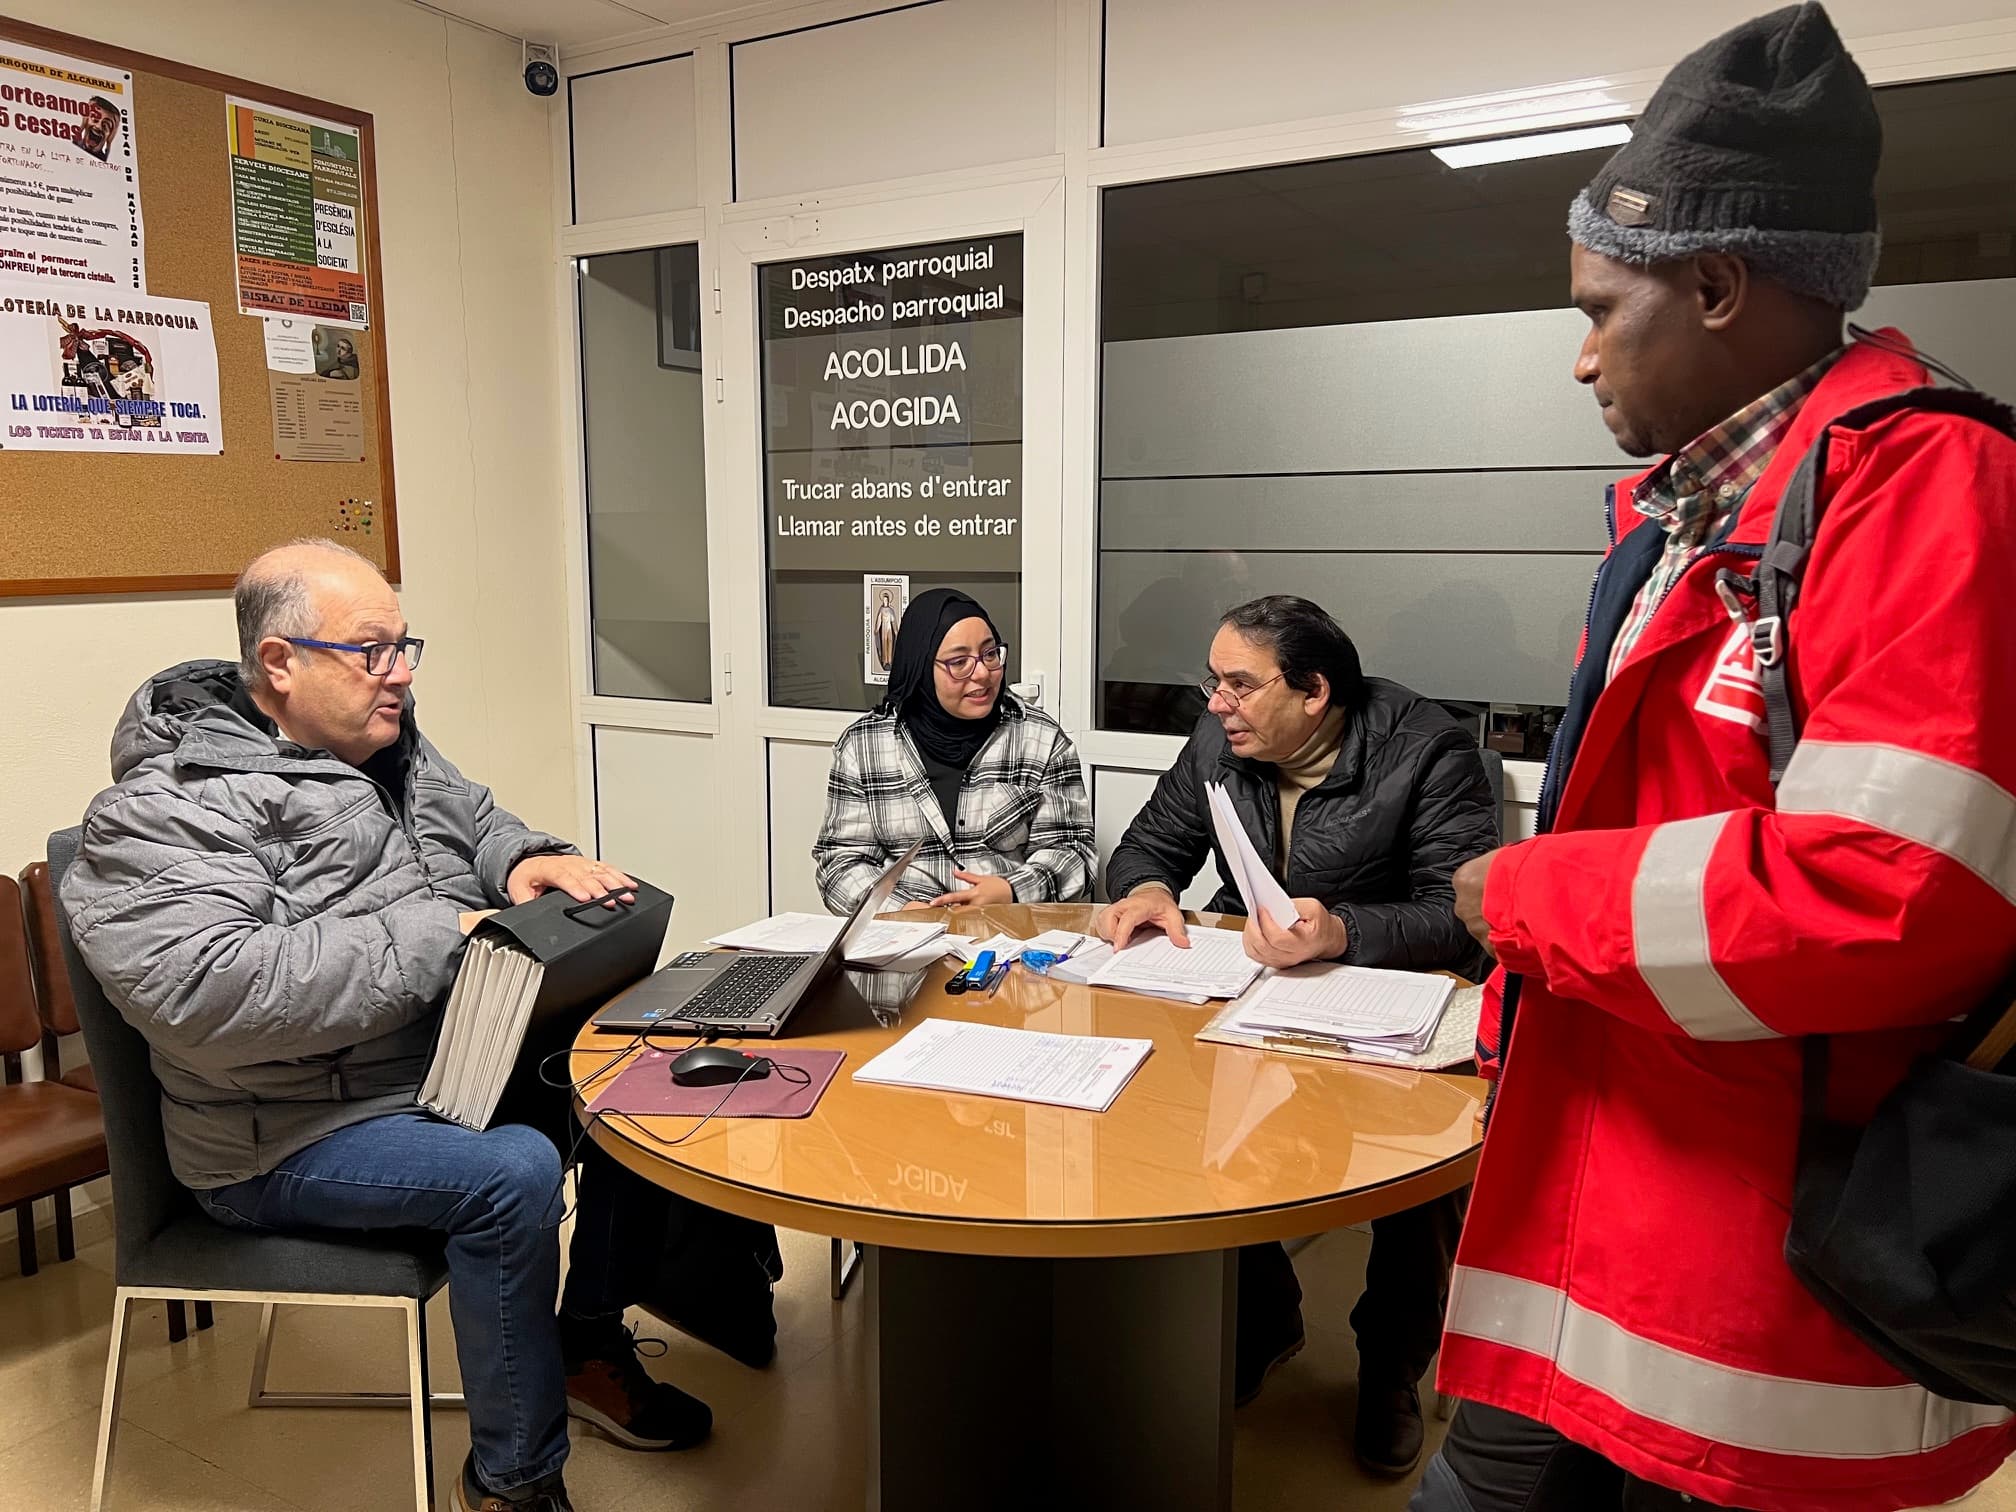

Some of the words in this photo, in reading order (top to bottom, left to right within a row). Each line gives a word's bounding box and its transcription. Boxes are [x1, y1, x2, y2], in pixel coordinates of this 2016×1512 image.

[1, 84, 103, 120] orteamos
[14, 112, 83, 143] cestas
[127, 192, 138, 247] NAVIDAD
[315, 202, 353, 221] PRESÈNCIA
[316, 219, 356, 238] D'ESGLÉSIA
[317, 237, 322, 248] A
[323, 238, 333, 250] LA
[318, 254, 349, 270] SOCIETAT
[792, 261, 875, 292] Despatx
[882, 245, 993, 286] parroquial
[242, 290, 285, 304] BISBAT
[289, 297, 305, 307] DE
[308, 299, 349, 313] LLEIDA
[784, 300, 885, 330] Despacho
[892, 284, 1004, 321] parroquial
[66, 304, 86, 319] DE
[94, 306, 113, 322] LA
[118, 308, 199, 330] PARROQUIA
[823, 341, 967, 381] ACOLLIDA
[11, 393, 29, 411] LA
[33, 393, 82, 414] LOTERÍA
[87, 397, 111, 415] QUE
[114, 398, 166, 417] SIEMPRE
[830, 394, 961, 430] ACOGIDA
[9, 425, 32, 438] LOS
[37, 426, 84, 440] TICKETS
[89, 427, 104, 440] YA
[147, 430, 155, 442] A
[159, 430, 173, 443] LA
[177, 431, 210, 444] VENTA
[782, 479, 844, 500] Trucar
[850, 477, 912, 500] abans
[919, 475, 1011, 498] d'entrar
[778, 515, 844, 536] Llamar
[851, 515, 907, 536] antes
[914, 514, 941, 536] de
[948, 514, 1017, 536] entrar
